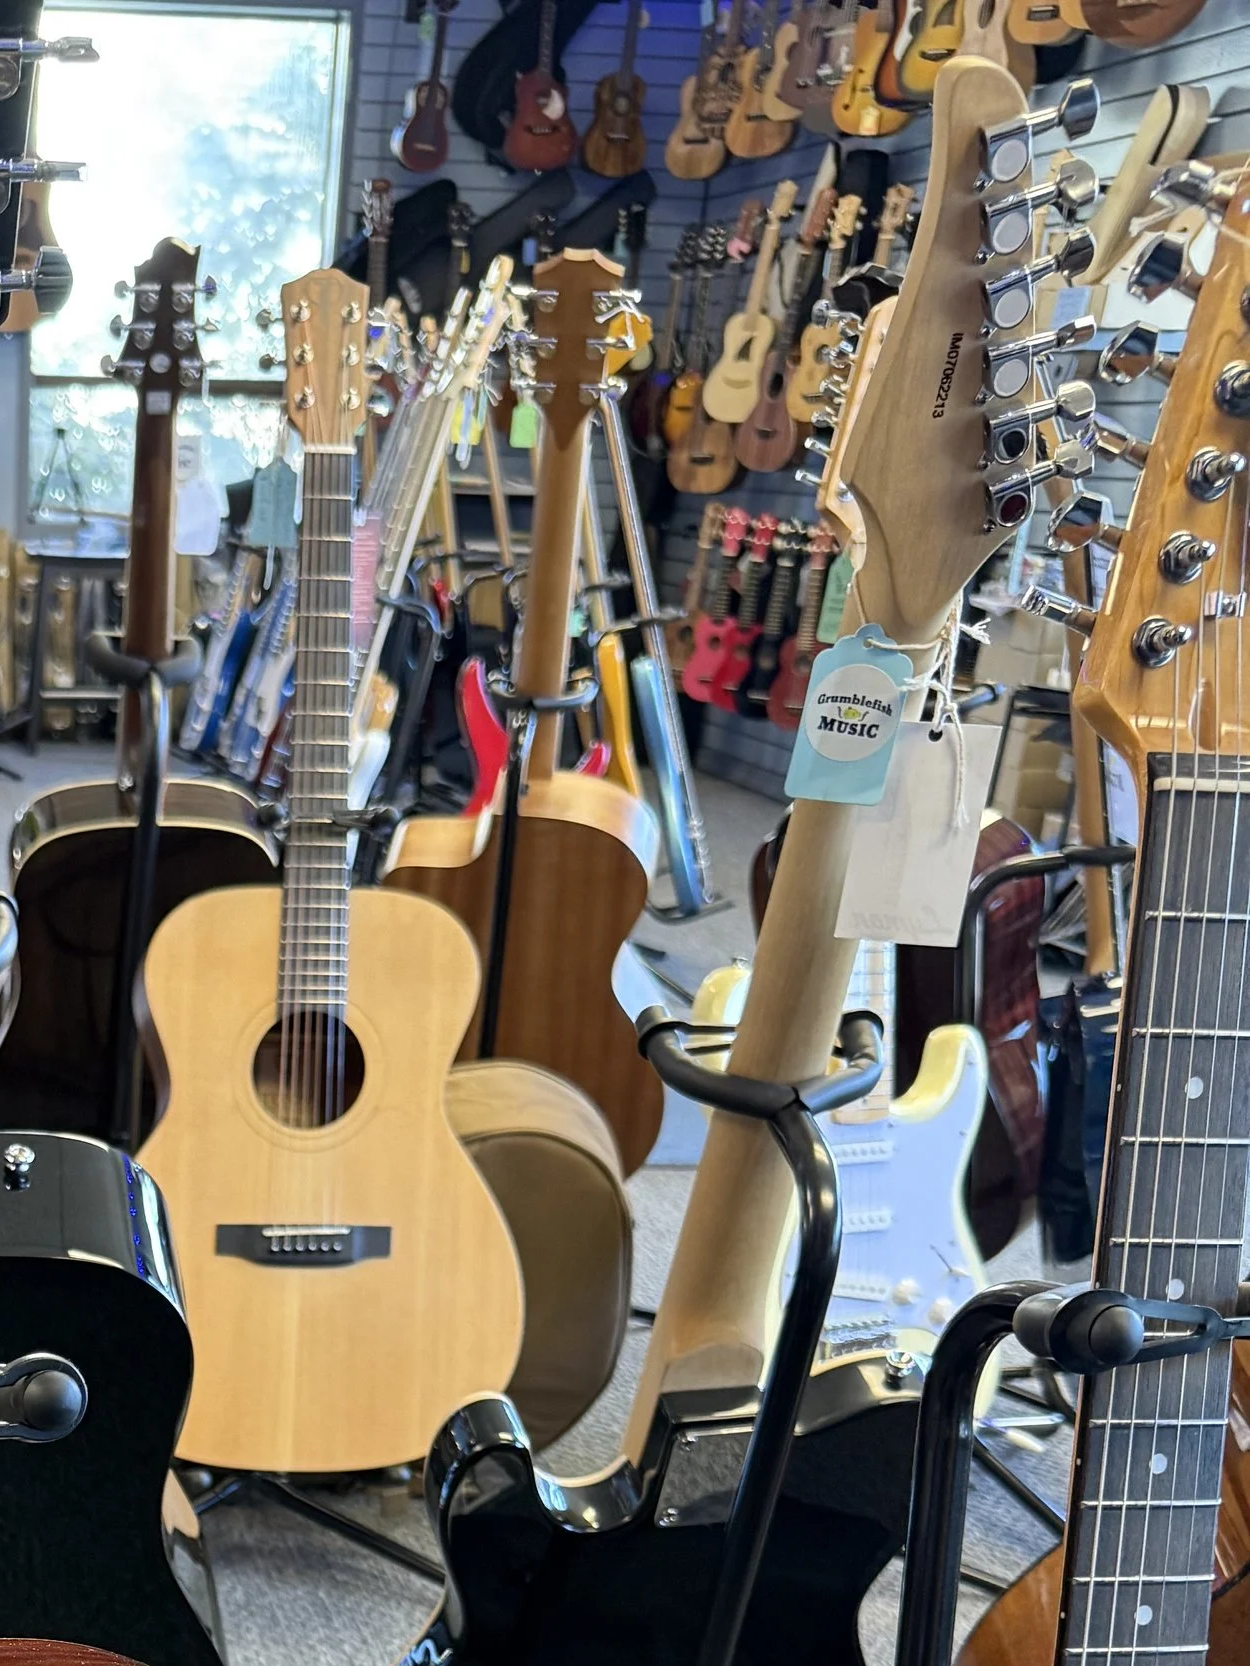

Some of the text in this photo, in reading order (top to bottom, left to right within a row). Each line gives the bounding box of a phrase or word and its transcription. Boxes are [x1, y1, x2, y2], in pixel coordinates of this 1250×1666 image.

[932, 332, 964, 419] IM07062213
[817, 692, 894, 718] Grumblefish
[817, 715, 880, 739] MUSIC
